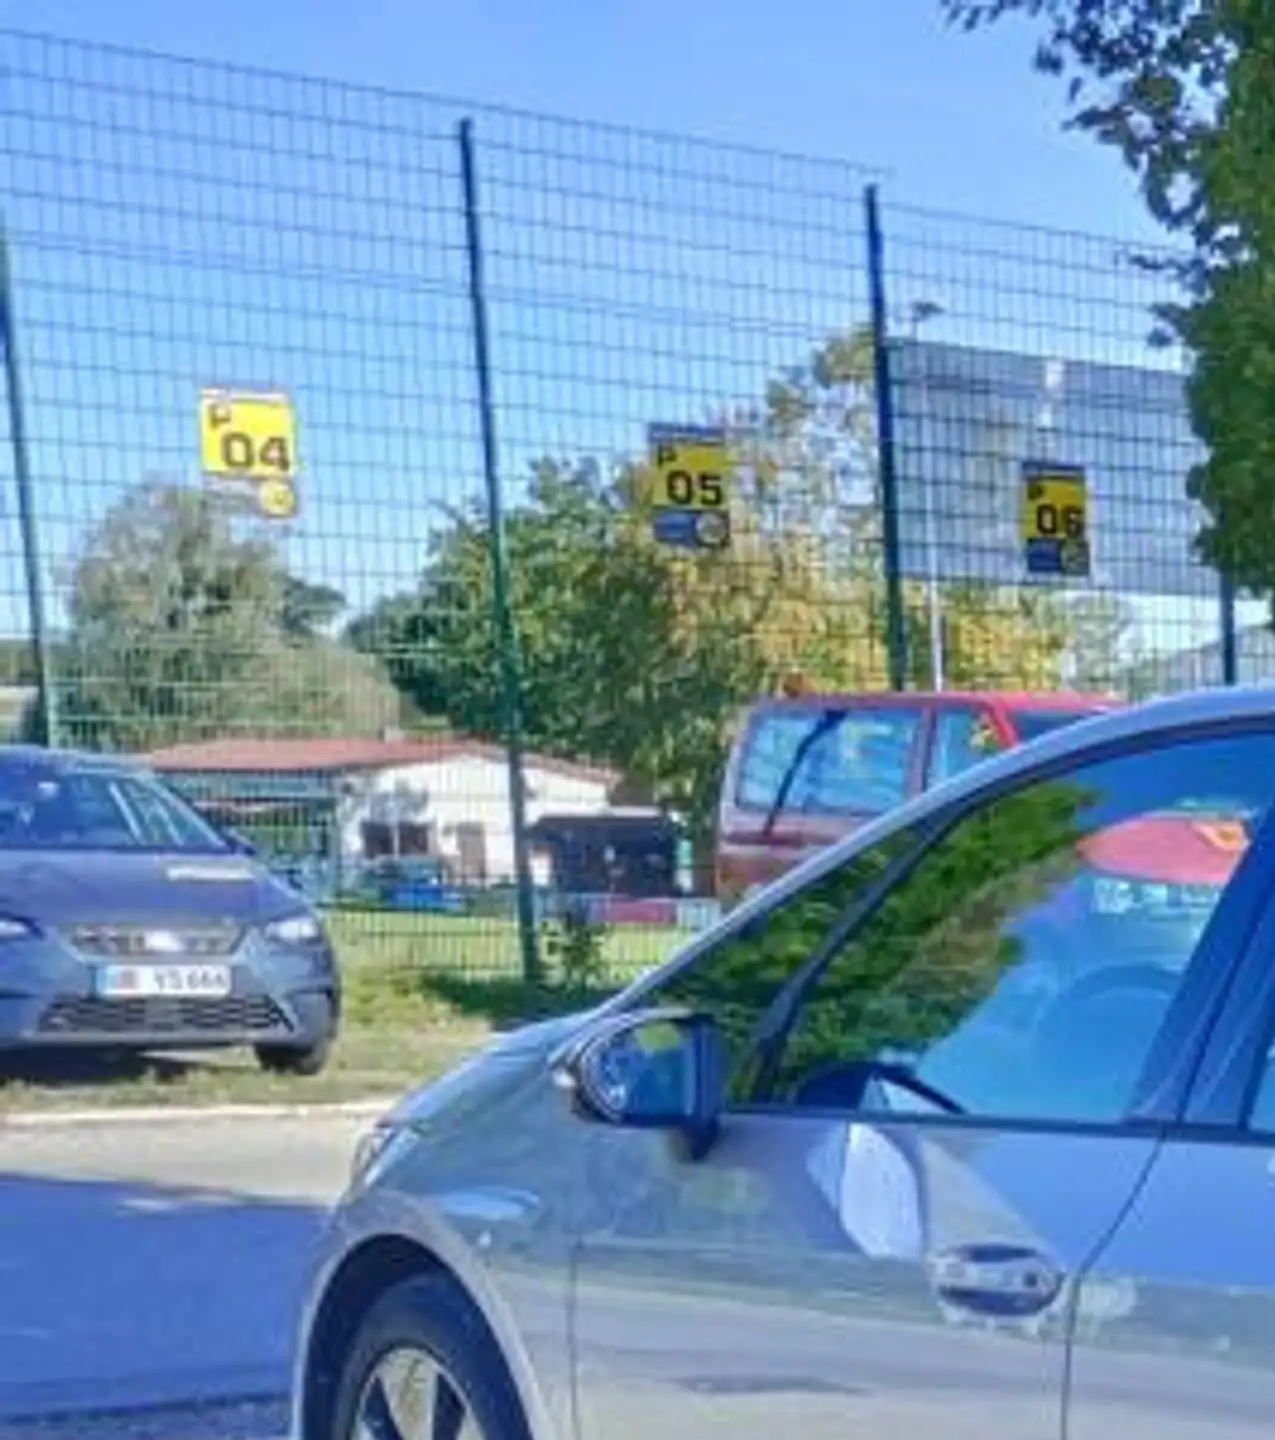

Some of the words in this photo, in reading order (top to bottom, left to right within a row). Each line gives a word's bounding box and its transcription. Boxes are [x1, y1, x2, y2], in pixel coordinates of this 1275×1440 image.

[221, 432, 290, 472] 04
[667, 469, 723, 506] 05
[1036, 502, 1084, 537] 06
